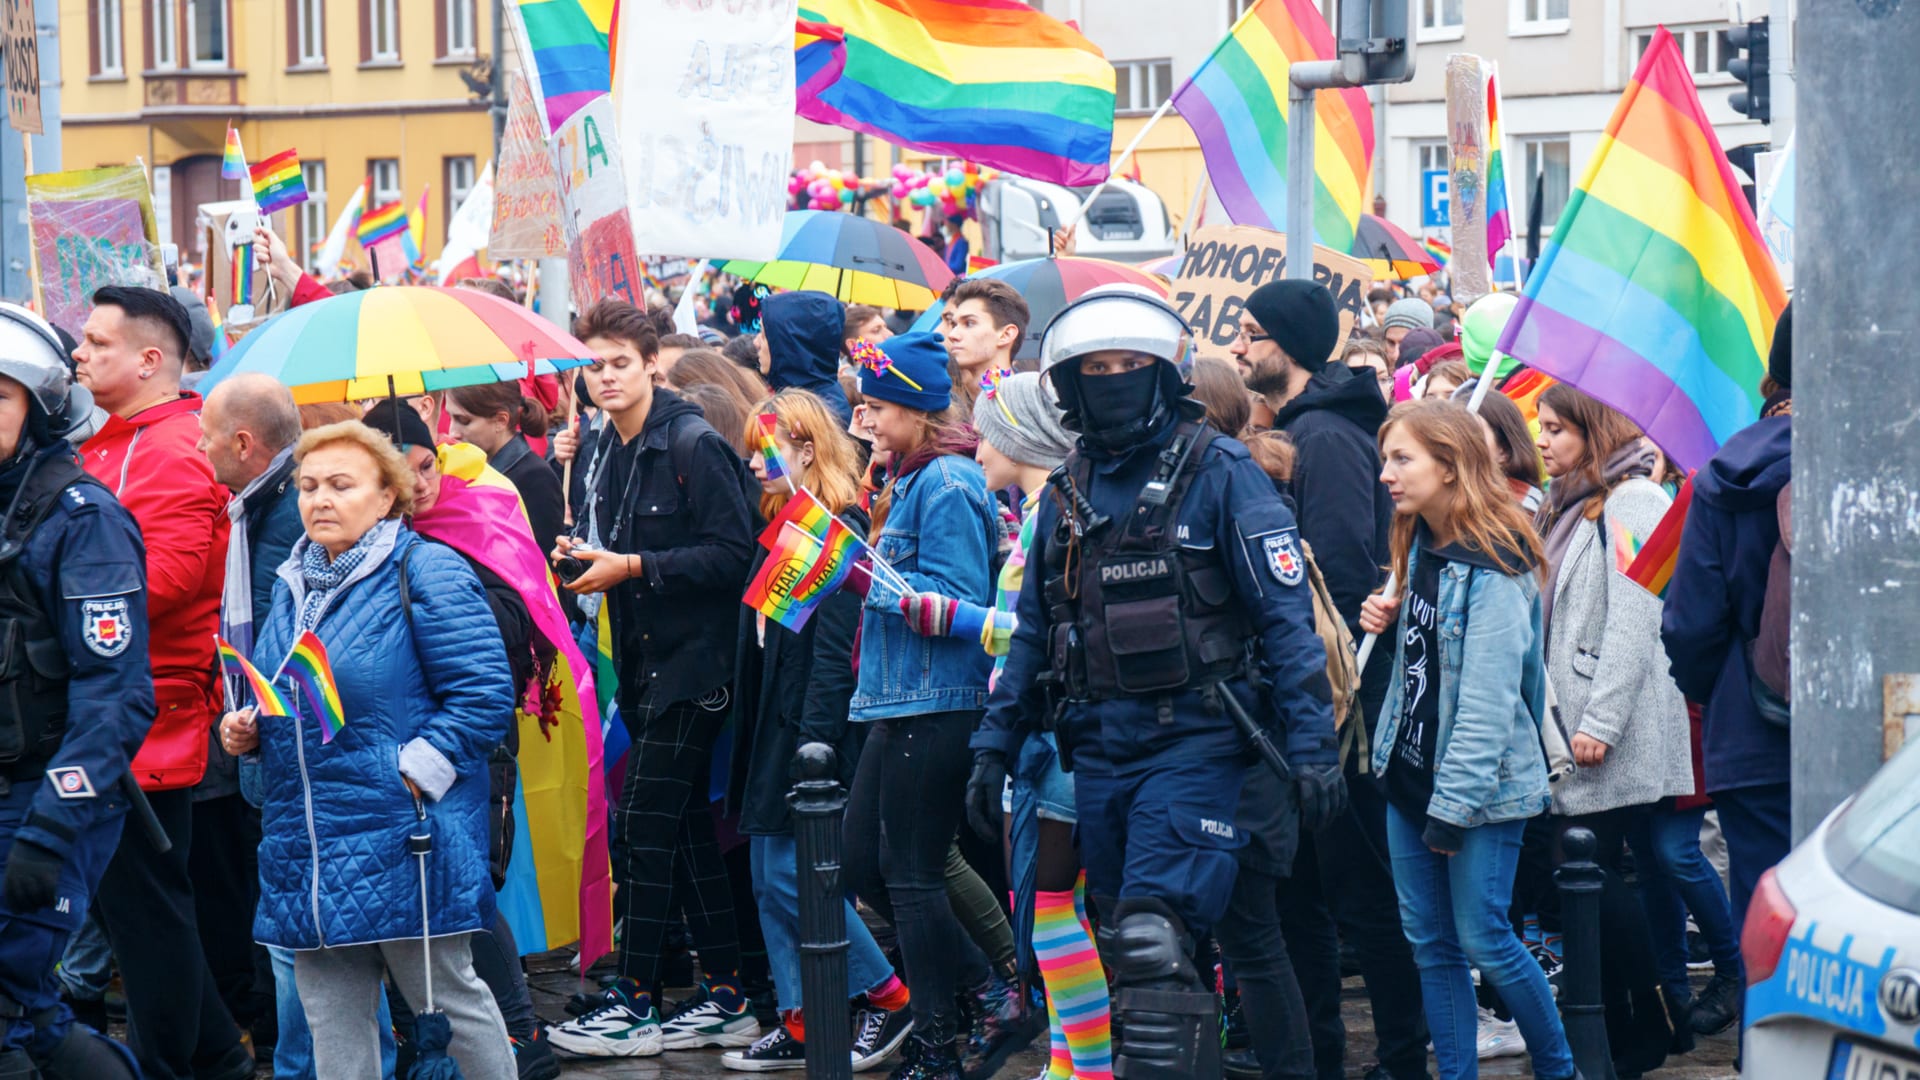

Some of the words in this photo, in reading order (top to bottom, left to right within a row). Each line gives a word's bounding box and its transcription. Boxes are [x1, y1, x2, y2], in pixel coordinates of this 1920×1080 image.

[1432, 175, 1450, 210] P
[1264, 534, 1291, 549] POLICJA
[814, 557, 838, 588] HAH
[1102, 559, 1168, 581] POLICJA
[771, 565, 801, 599] HAH
[86, 601, 125, 612] POLICJA
[1200, 818, 1234, 839] POLICJA
[1786, 947, 1864, 1018] POLICJA
[637, 1027, 653, 1038] FILA
